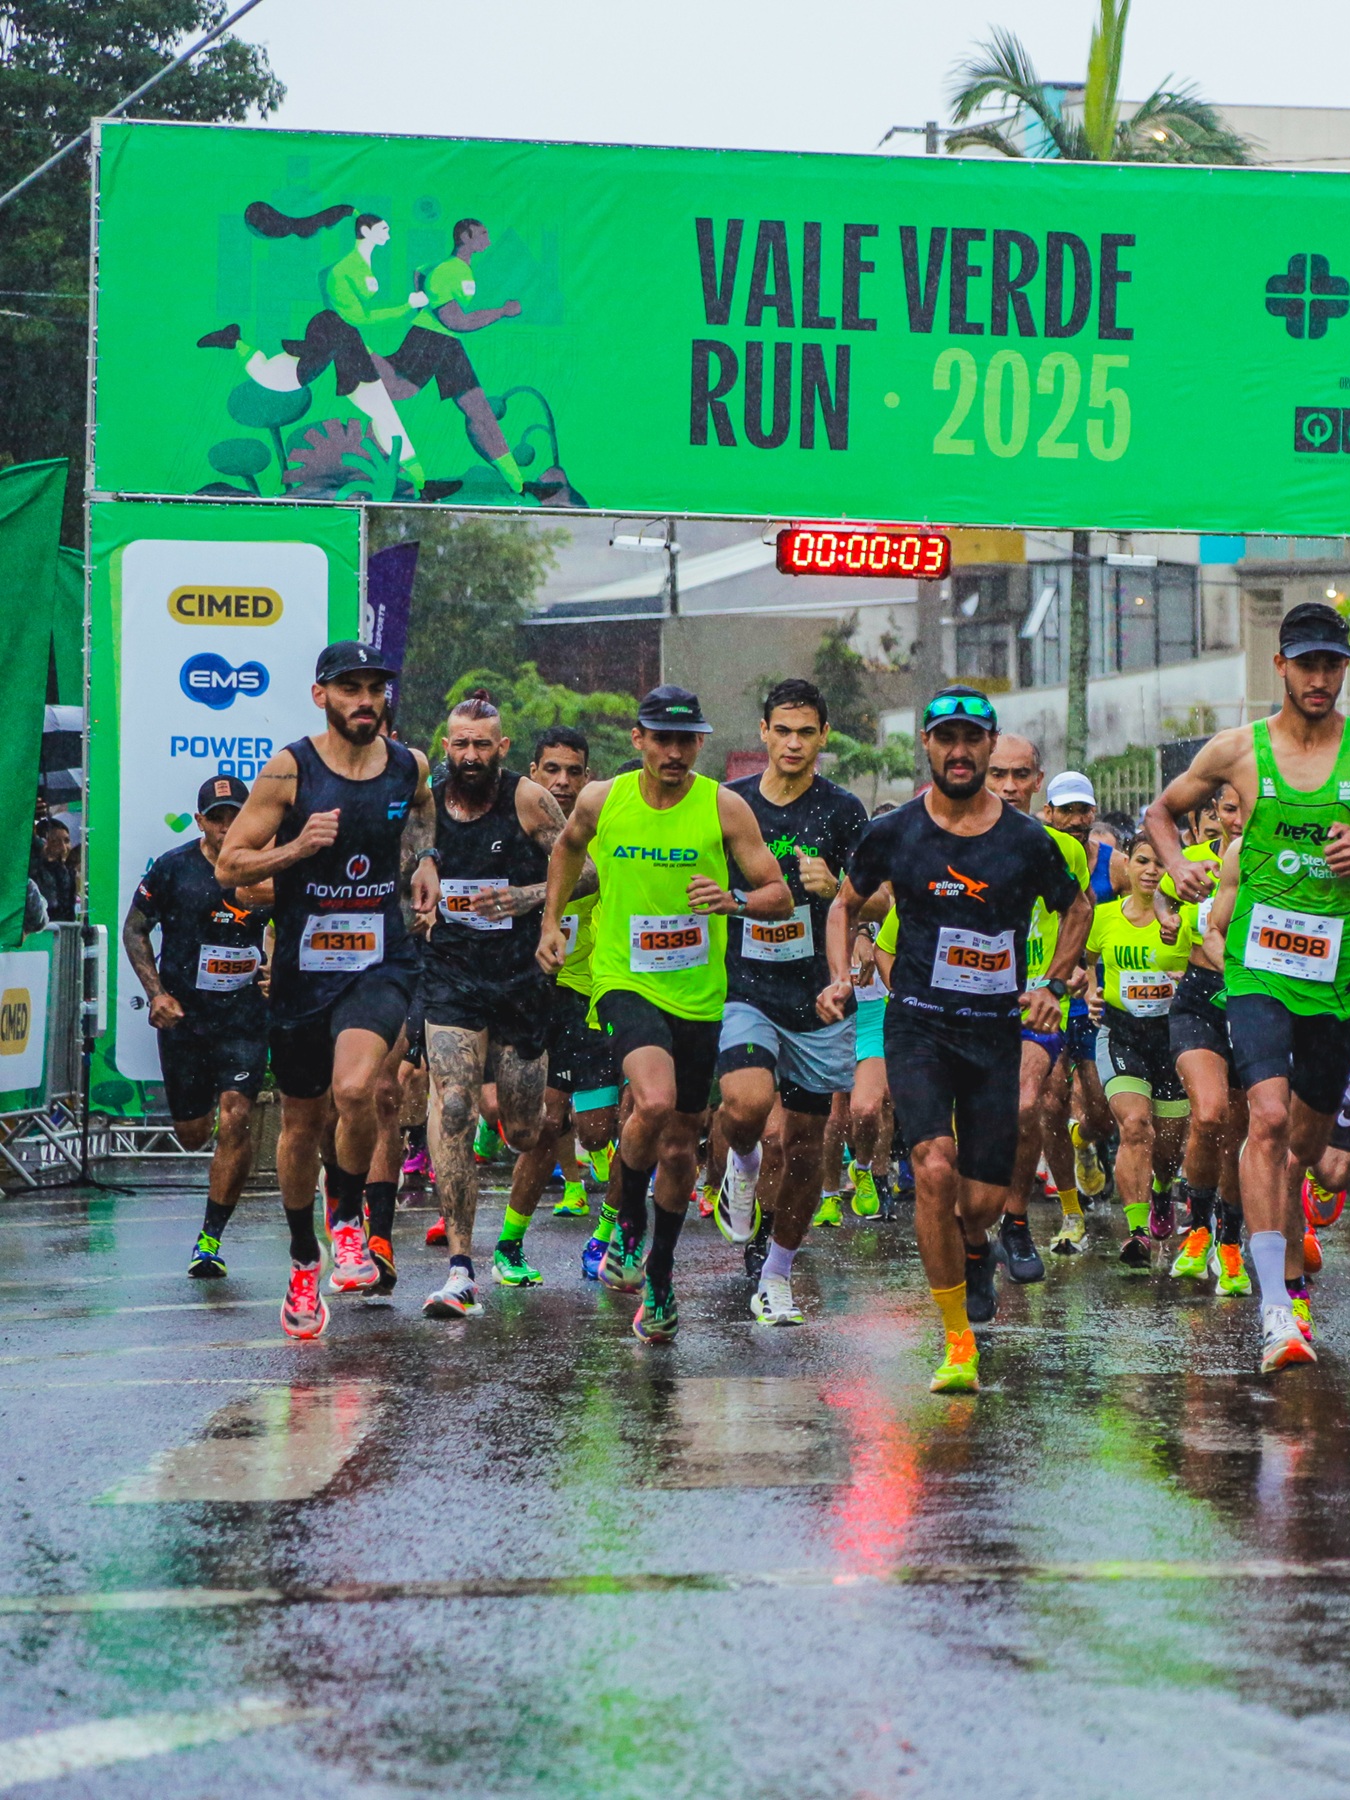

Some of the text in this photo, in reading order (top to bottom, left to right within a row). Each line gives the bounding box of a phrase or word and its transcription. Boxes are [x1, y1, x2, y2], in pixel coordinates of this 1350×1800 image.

[695, 217, 1136, 341] VALE VERDE
[689, 338, 1132, 462] RUN 2025
[792, 532, 943, 572] 00:00:03
[175, 593, 274, 619] CIMED
[188, 669, 260, 688] EMS
[170, 735, 273, 759] POWER
[613, 845, 699, 862] ATHLED
[928, 881, 965, 890] Believe
[319, 933, 366, 950] 1311
[643, 930, 699, 949] 1339
[756, 925, 798, 943] 1198
[1264, 930, 1326, 957] 1098
[211, 960, 252, 974] 1352
[953, 949, 1007, 971] 1357
[1114, 945, 1151, 970] VALE
[1130, 985, 1171, 999] 1442
